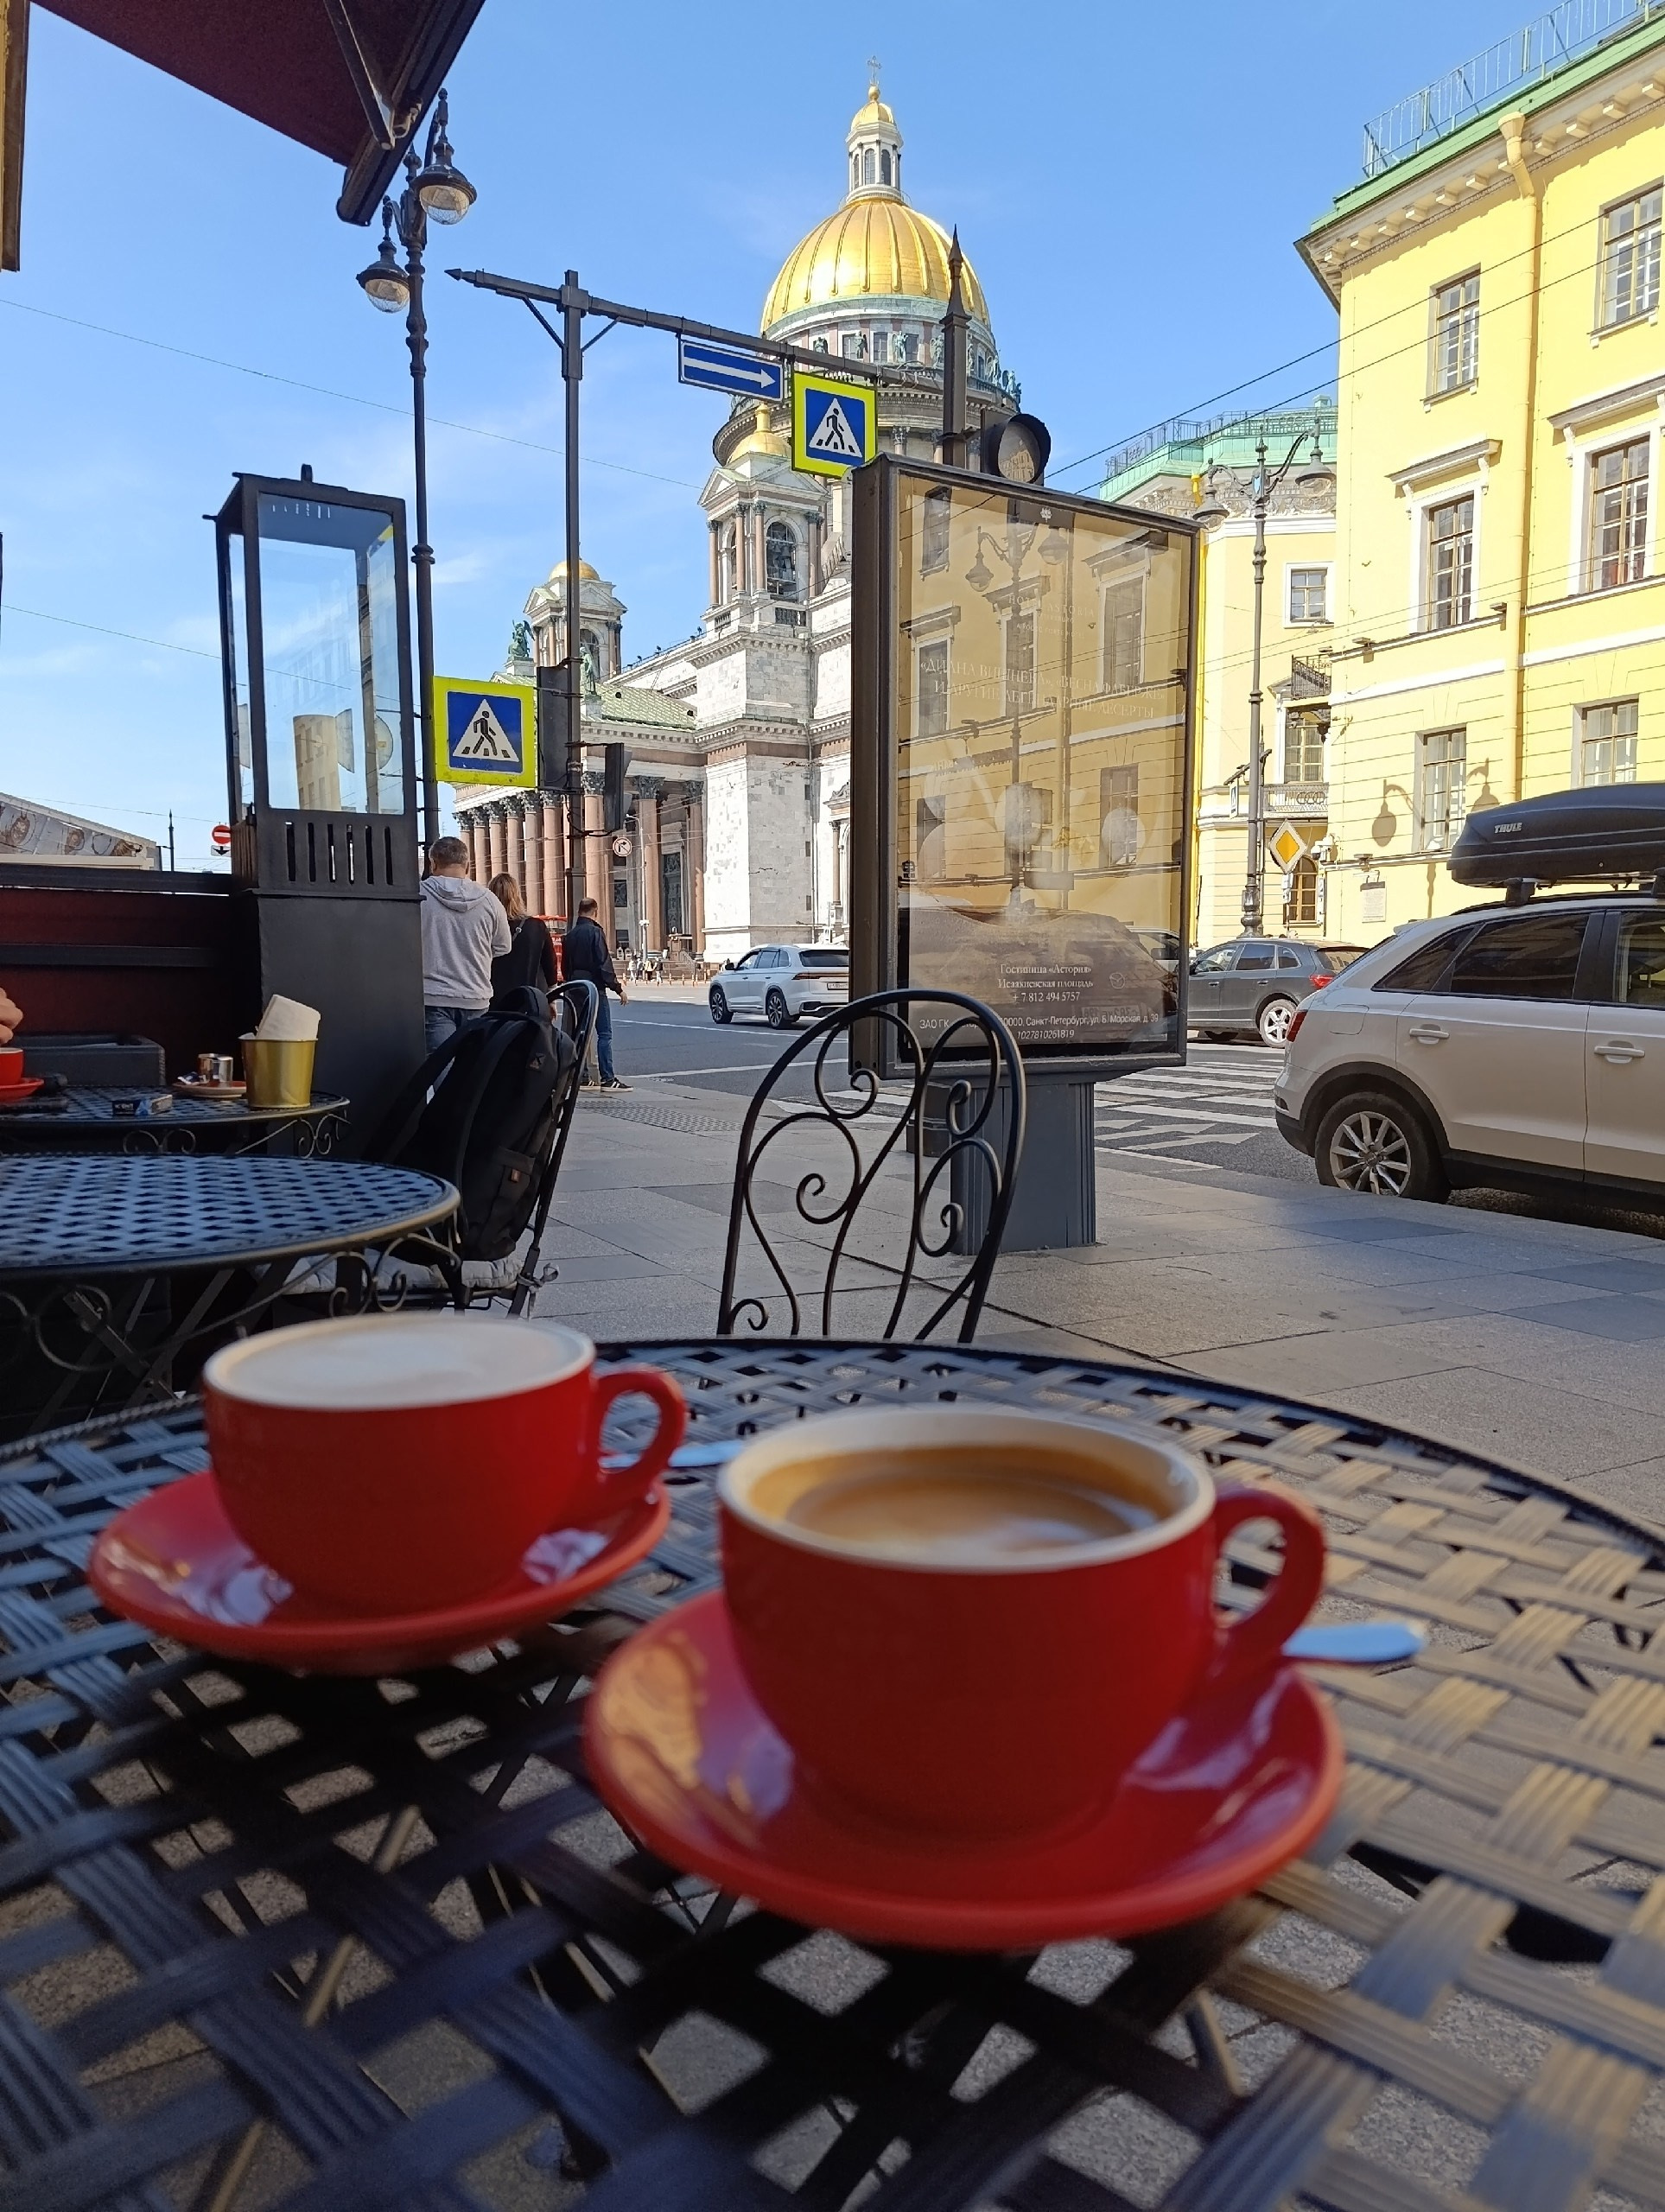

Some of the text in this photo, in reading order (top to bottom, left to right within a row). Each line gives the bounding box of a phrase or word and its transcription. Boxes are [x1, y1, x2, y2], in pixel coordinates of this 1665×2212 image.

[1048, 602, 1095, 617] ASTORIA
[1494, 823, 1522, 834] THULE
[1001, 963, 1092, 976] Гостиница «Астория»
[997, 978, 1094, 988] Исаакиевская площадь
[1028, 992, 1045, 1002] 812
[1045, 992, 1060, 1001] 494
[1061, 991, 1081, 1001] 5757
[919, 1020, 937, 1029] ЗАО
[938, 1020, 950, 1028] ГК
[1026, 1014, 1090, 1027] Санкт-Петербург,
[1109, 1014, 1141, 1025] Морская,
[1150, 1013, 1159, 1022] 39
